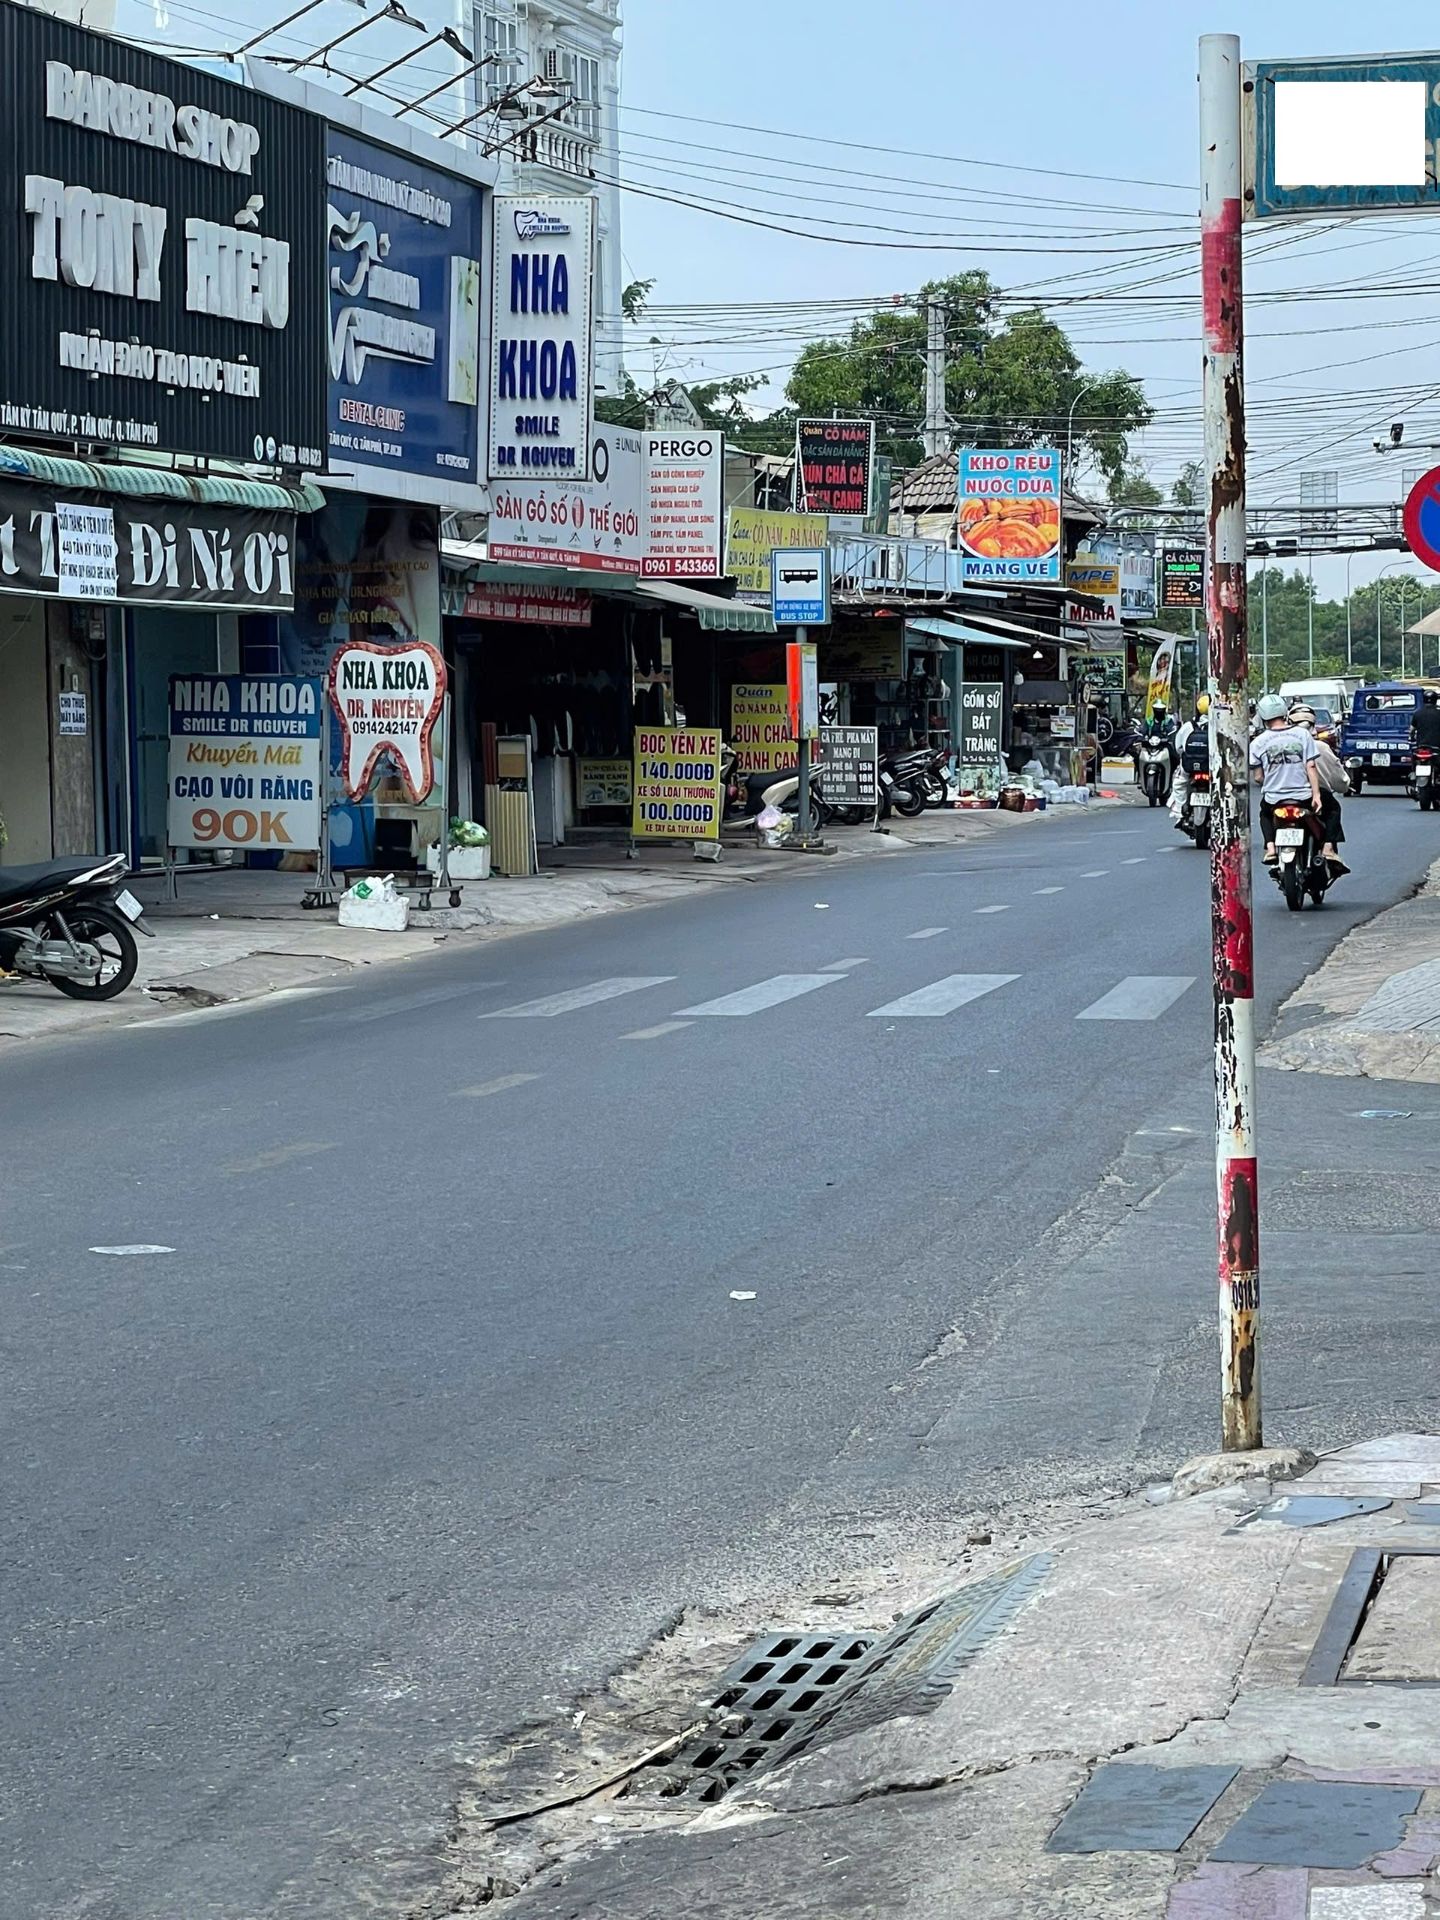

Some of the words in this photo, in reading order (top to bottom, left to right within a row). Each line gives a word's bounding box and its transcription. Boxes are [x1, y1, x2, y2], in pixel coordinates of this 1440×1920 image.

[46, 60, 177, 152] BARBER
[177, 104, 260, 175] SHOP
[25, 175, 167, 302] TONY
[185, 194, 290, 329] HIẾU
[510, 254, 569, 314] NHA
[59, 328, 114, 379] NHẬN
[115, 335, 155, 380] ĐÀO
[154, 349, 189, 395] TẠO
[189, 355, 223, 402] HỌC
[223, 354, 260, 398] VIÊN
[498, 340, 578, 400] KHOA
[1, 401, 19, 427] TÂN
[33, 406, 49, 431] TÂN
[80, 412, 97, 437] TÂN
[126, 418, 141, 442] TÂN
[142, 421, 158, 445] PHÚ
[339, 398, 376, 427] DENTAL
[375, 405, 405, 433] CLINIC
[515, 415, 560, 436] SMILE
[824, 426, 839, 440] CÔ
[842, 426, 866, 441] NĂM
[497, 446, 518, 467] DR
[523, 446, 576, 468] NGUYEN
[649, 440, 713, 457] PERGO
[825, 460, 847, 485] CHẢ
[849, 463, 864, 485] CÁ
[969, 455, 1010, 471] KHO
[833, 490, 862, 509] CANH
[496, 489, 522, 520] SÀN
[526, 490, 547, 522] GỖ
[550, 494, 568, 526] SỐ
[589, 502, 612, 532] THẾ
[613, 508, 639, 536] GIỚI
[128, 522, 180, 588] Đi
[187, 528, 234, 591] Ní
[243, 531, 294, 595] Ơi
[645, 560, 671, 573] 0961
[674, 560, 715, 573] 543366
[1166, 551, 1177, 562] CÁ
[966, 563, 1020, 575] MANG
[1069, 570, 1115, 581] MPE
[780, 612, 797, 620] BUS
[798, 612, 819, 620] STOP
[343, 661, 378, 690] NHA
[382, 661, 429, 690] KHOA
[175, 681, 230, 712] NHA
[241, 682, 315, 715] KHOA
[735, 686, 773, 698] Quán
[963, 689, 985, 708] GỐM
[986, 691, 1000, 708] SỨ
[347, 699, 368, 719] DR.
[372, 692, 425, 719] NGUYỄN
[183, 718, 226, 732] SMILE
[230, 719, 249, 733] DR
[253, 720, 307, 734] NGUYEN
[352, 721, 418, 735] 0914242147
[735, 720, 760, 743] BÚN
[764, 716, 789, 744] CHẢ
[972, 712, 991, 730] BÁT
[640, 734, 666, 758] BỌC
[671, 731, 696, 755] YÊN
[699, 736, 716, 755] XE
[846, 732, 860, 744] PHA
[965, 734, 997, 752] TRÀNG
[186, 741, 259, 767] Khuyến
[736, 746, 770, 769] BÁNH
[833, 747, 852, 758] MANG
[640, 761, 715, 781] 140.000Đ
[175, 776, 214, 802] CẠO
[220, 774, 254, 799] VÔI
[260, 775, 313, 801] RĂNG
[637, 786, 648, 797] XE
[650, 783, 660, 797] SỐ
[640, 802, 714, 822] 100.000Đ
[191, 808, 293, 843] 90K
[645, 824, 652, 832] XE
[655, 824, 665, 832] TAY
[667, 824, 676, 832] GA
